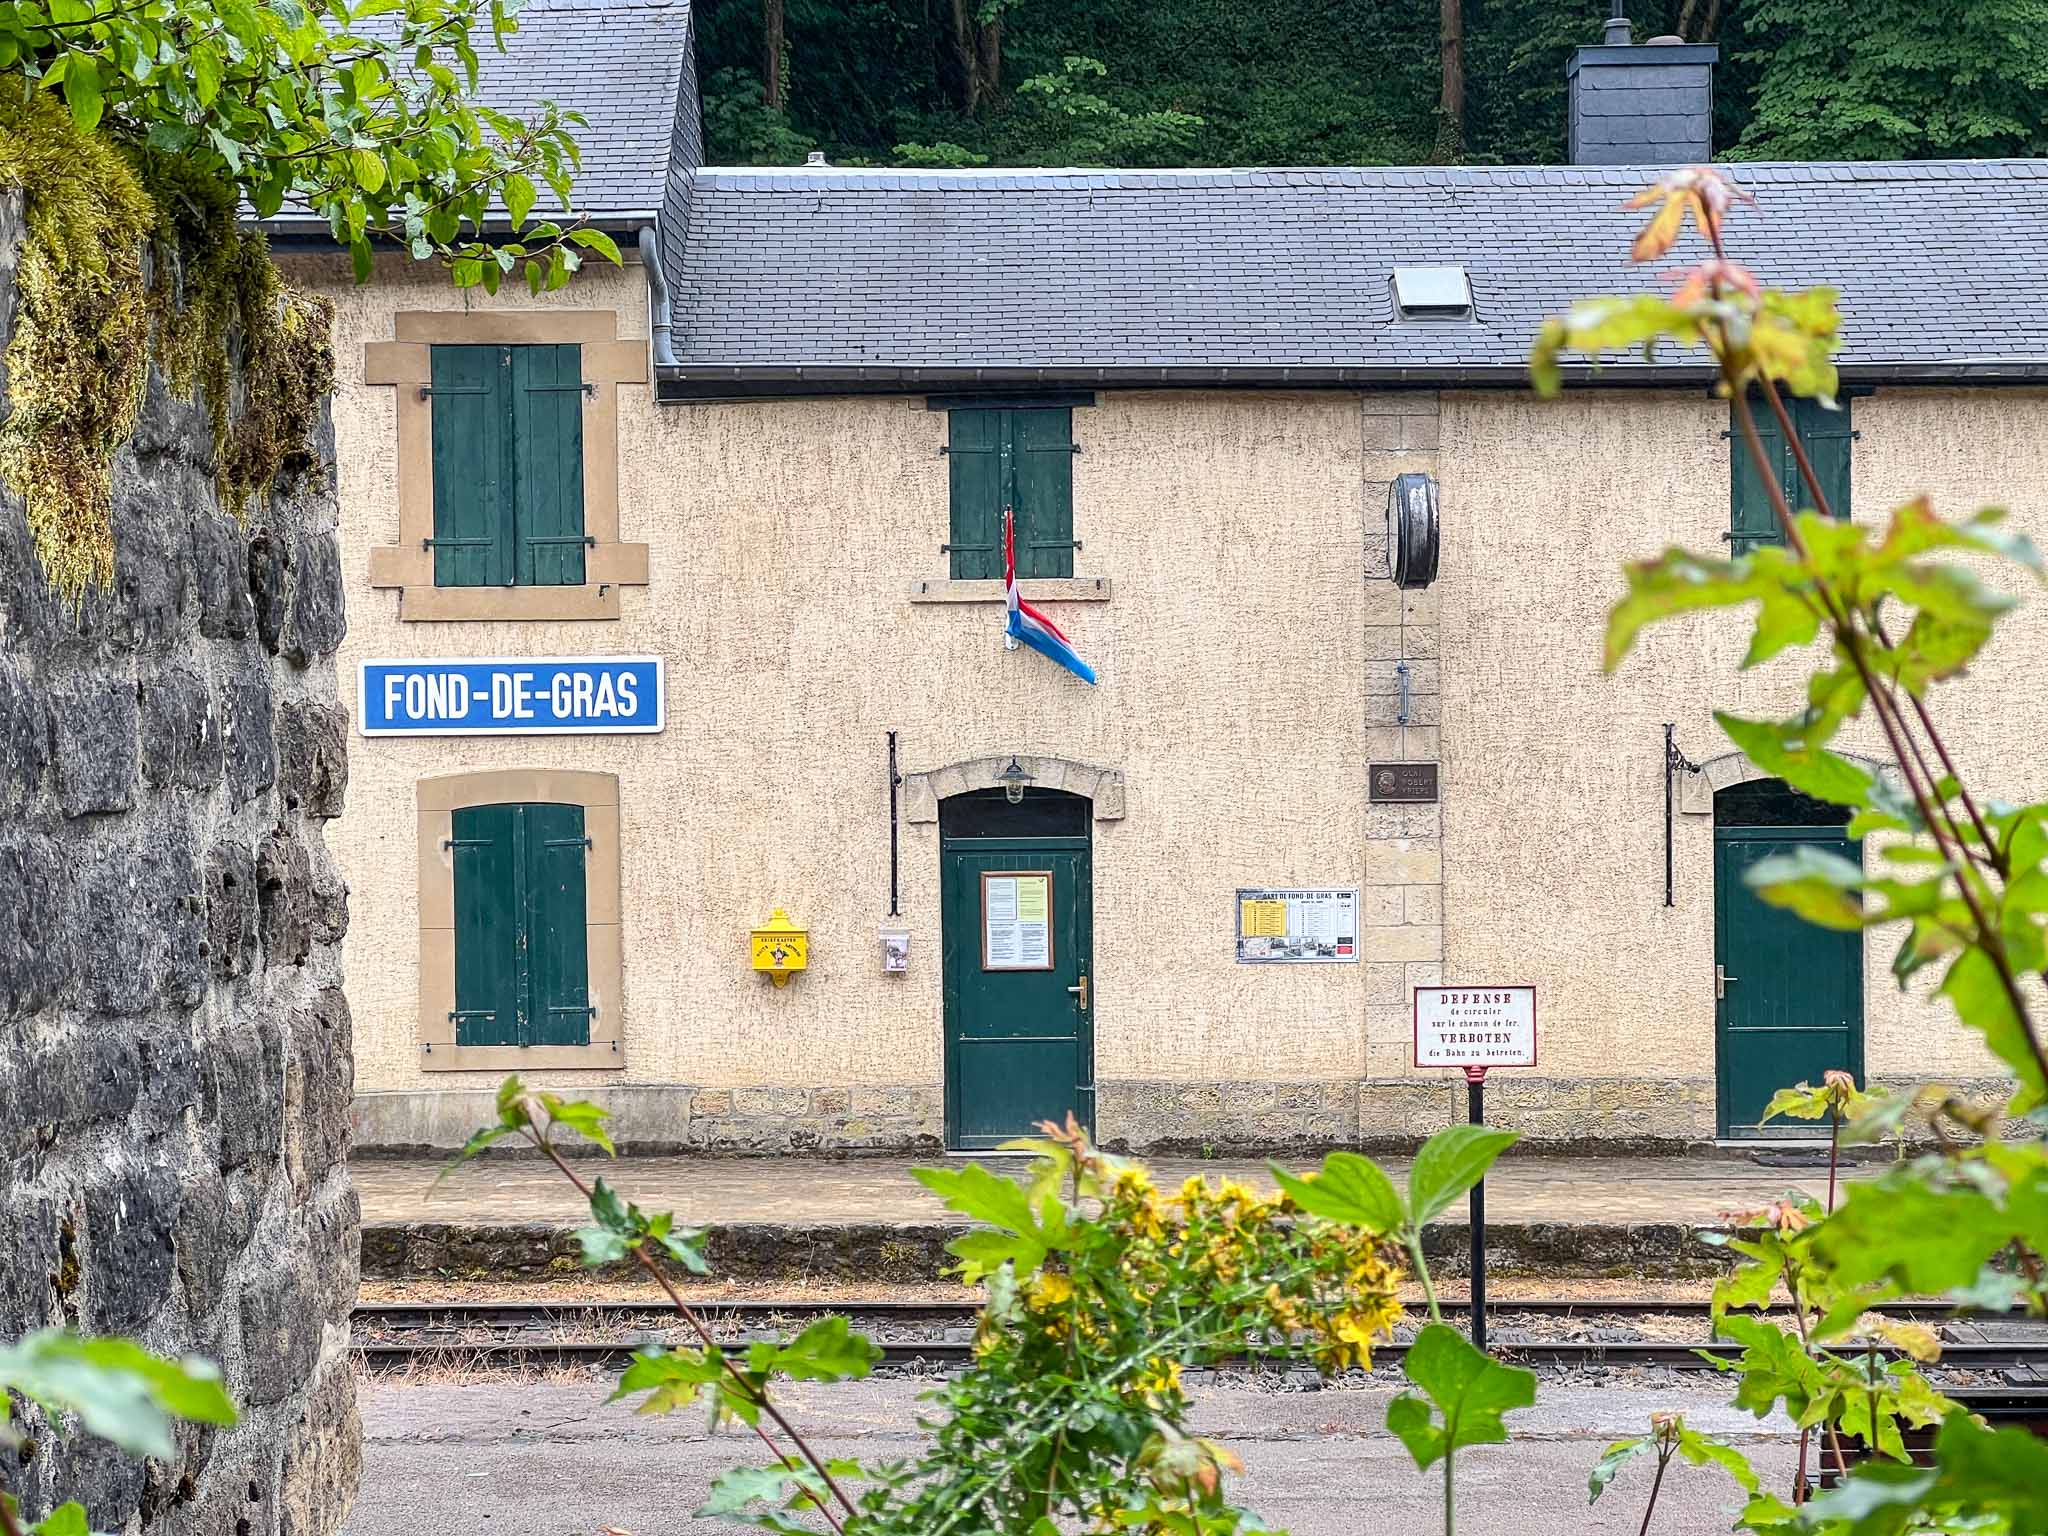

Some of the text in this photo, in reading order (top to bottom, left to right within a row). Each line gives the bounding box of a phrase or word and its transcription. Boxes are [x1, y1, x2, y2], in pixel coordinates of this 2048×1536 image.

[384, 671, 638, 720] FOND-DE-GRAS
[1440, 993, 1512, 1005] DEFENSE
[1432, 1019, 1520, 1028] sur le chemin de fer.
[1440, 1033, 1512, 1044] VERBOTEN
[1428, 1049, 1440, 1057] die
[1446, 1049, 1466, 1057] Bahn
[1470, 1049, 1480, 1057] zu
